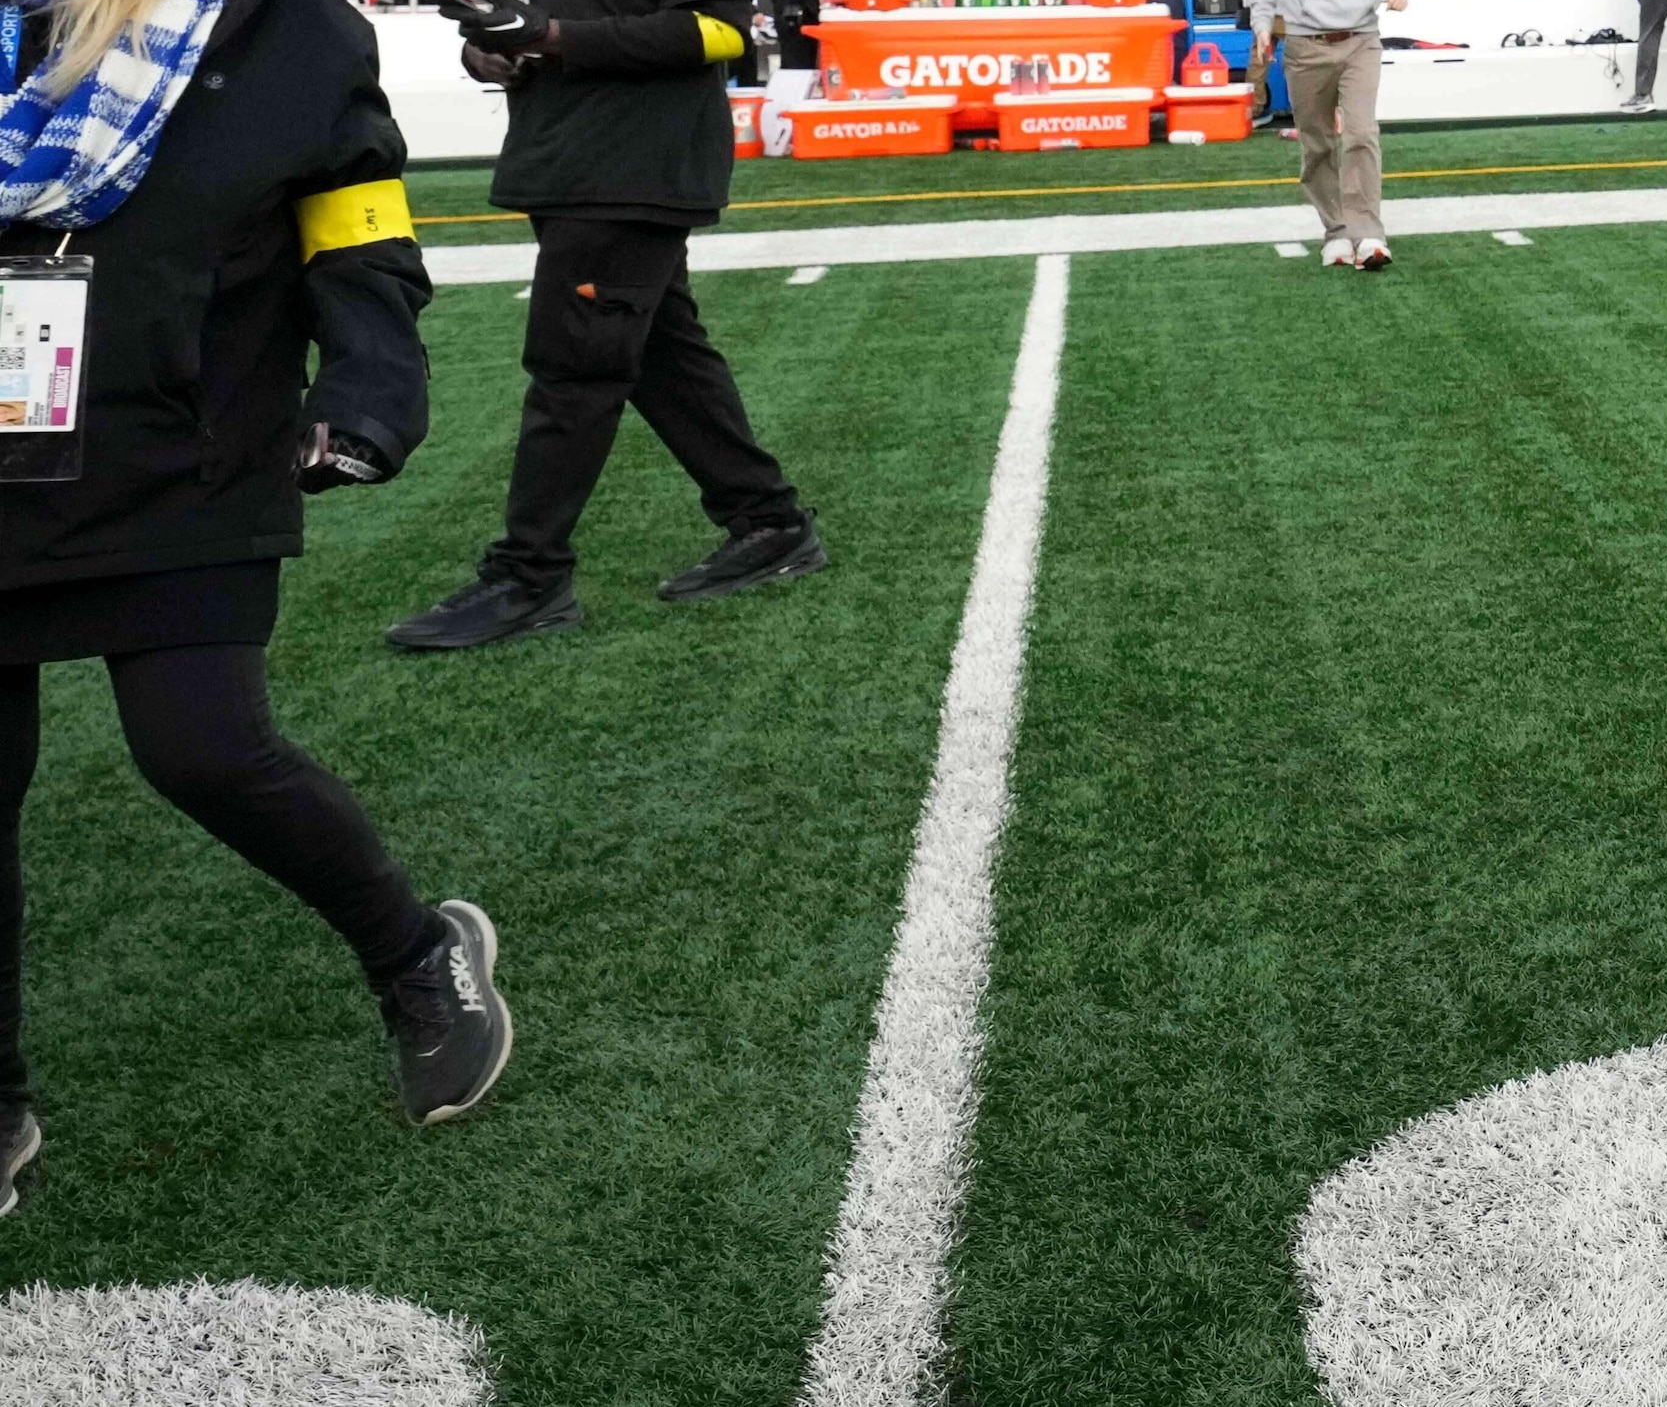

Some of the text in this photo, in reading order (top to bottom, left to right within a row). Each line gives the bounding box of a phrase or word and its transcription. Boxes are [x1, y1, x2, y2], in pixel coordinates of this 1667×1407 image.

[0, 5, 20, 53] SPORTS
[1020, 114, 1128, 133] GATORADE
[53, 364, 72, 409] BROADCAST
[448, 943, 487, 1013] HOKA
